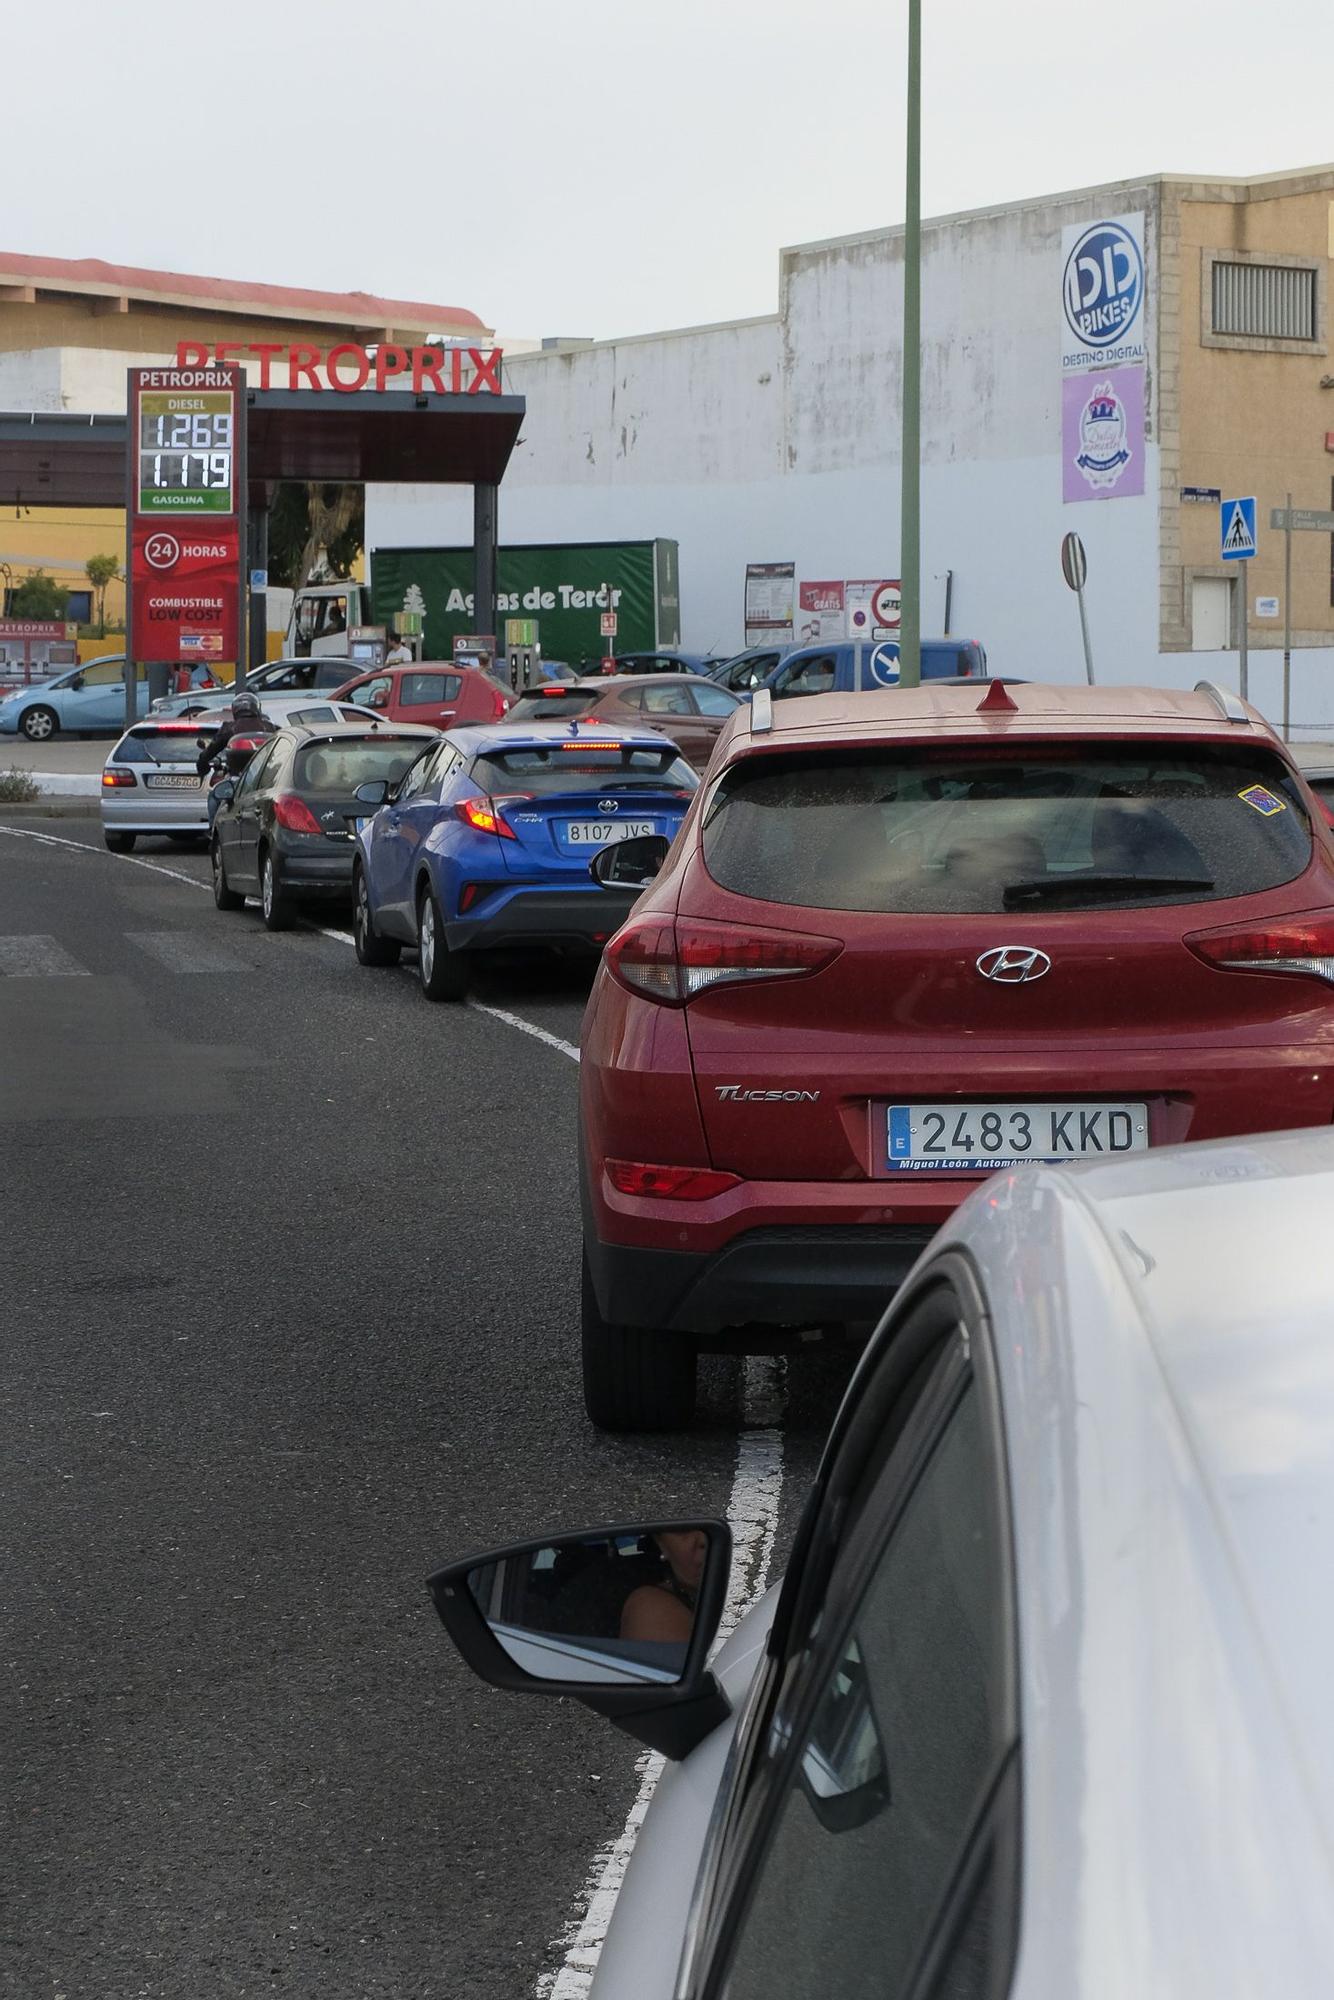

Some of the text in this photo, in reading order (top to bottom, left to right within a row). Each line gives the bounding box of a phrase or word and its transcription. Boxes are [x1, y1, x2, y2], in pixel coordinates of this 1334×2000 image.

[1080, 297, 1131, 333] BIKES
[1063, 344, 1144, 367] DESTINO DIGITAL
[140, 371, 233, 386] PETROPRIX
[168, 399, 206, 410] DIESEL
[157, 414, 231, 448] 1.269
[153, 453, 230, 488] 1.179
[152, 496, 204, 505] GASOLINA
[151, 543, 227, 557] 24 HORAS
[149, 598, 223, 608] COMBUSTIBLE
[445, 588, 520, 617] Agas
[522, 586, 555, 610] de
[814, 600, 841, 610] GRATIS
[149, 609, 222, 620] LOW COST
[570, 825, 651, 841] 8107 JVS
[922, 1111, 1133, 1153] 2483 KKD
[896, 1138, 905, 1149] E
[900, 1160, 938, 1170] Miguel
[942, 1159, 969, 1168] León
